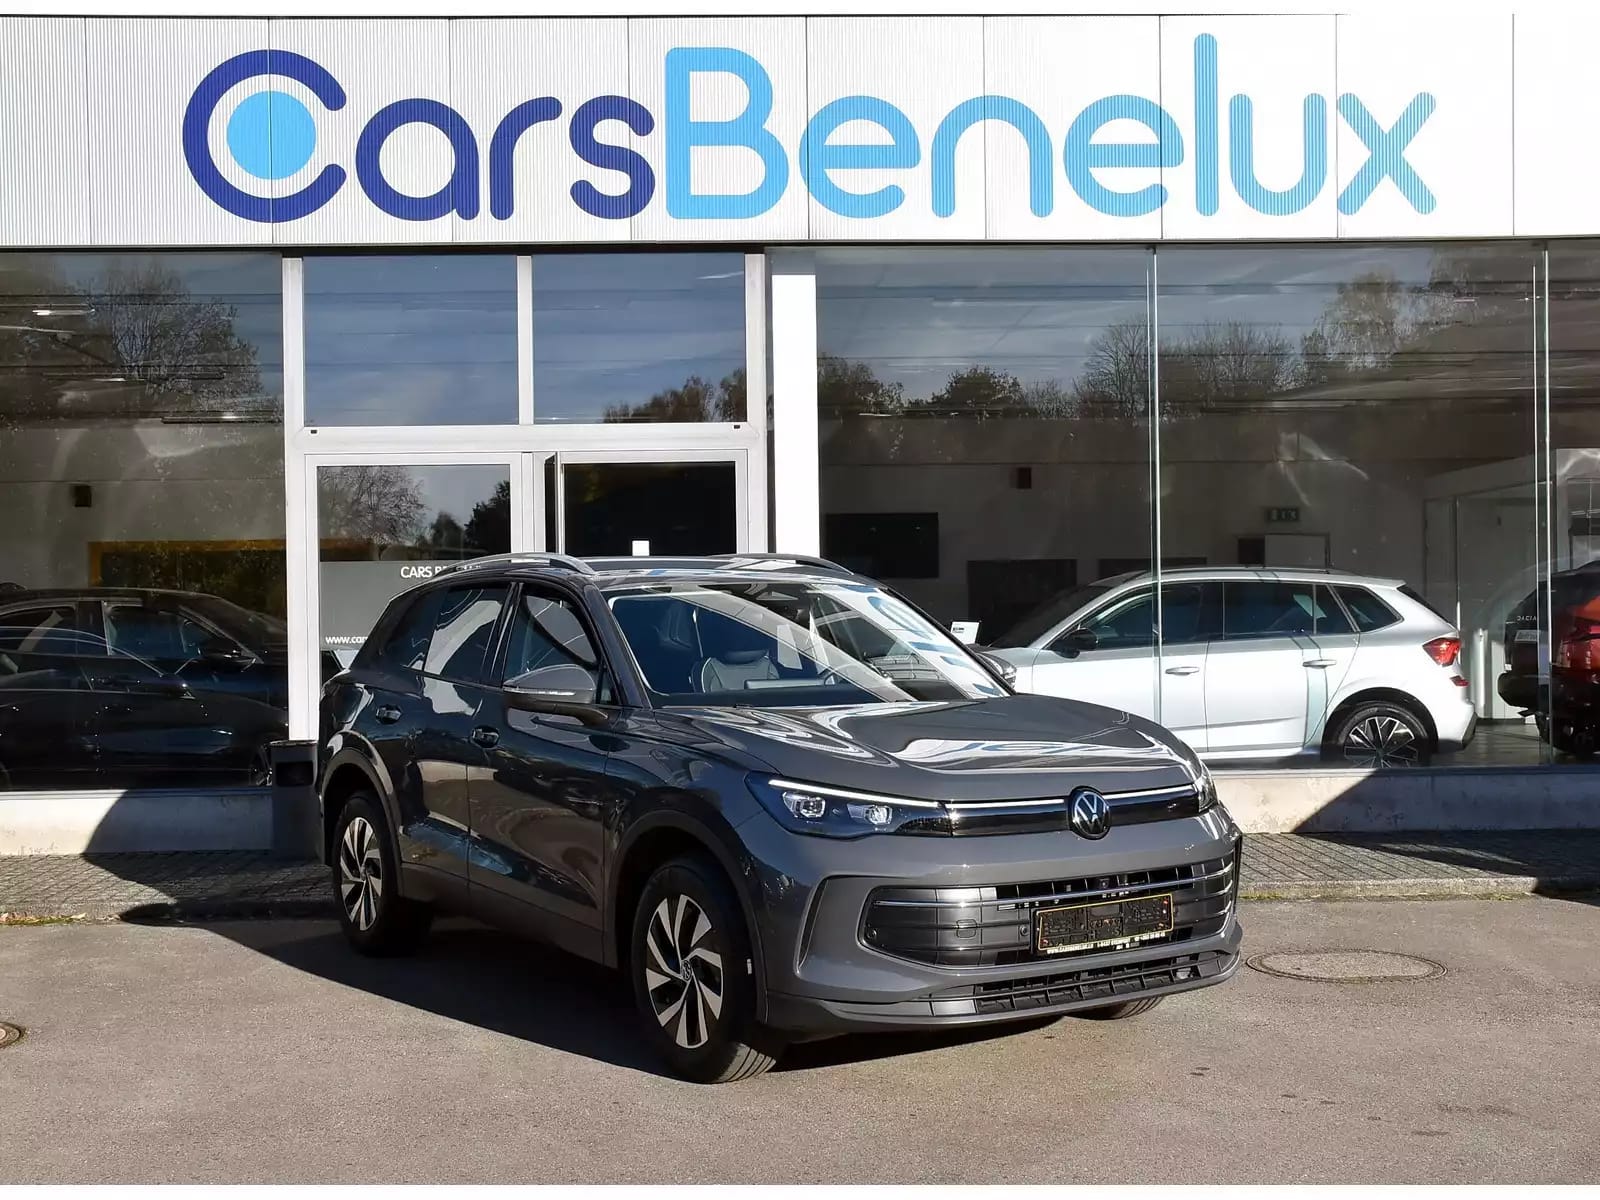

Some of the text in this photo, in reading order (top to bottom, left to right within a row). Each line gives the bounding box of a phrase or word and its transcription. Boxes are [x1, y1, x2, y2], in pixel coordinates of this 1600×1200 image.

[183, 33, 1436, 221] CarsBenelux
[400, 565, 433, 578] CARS
[325, 636, 368, 644] www.car
